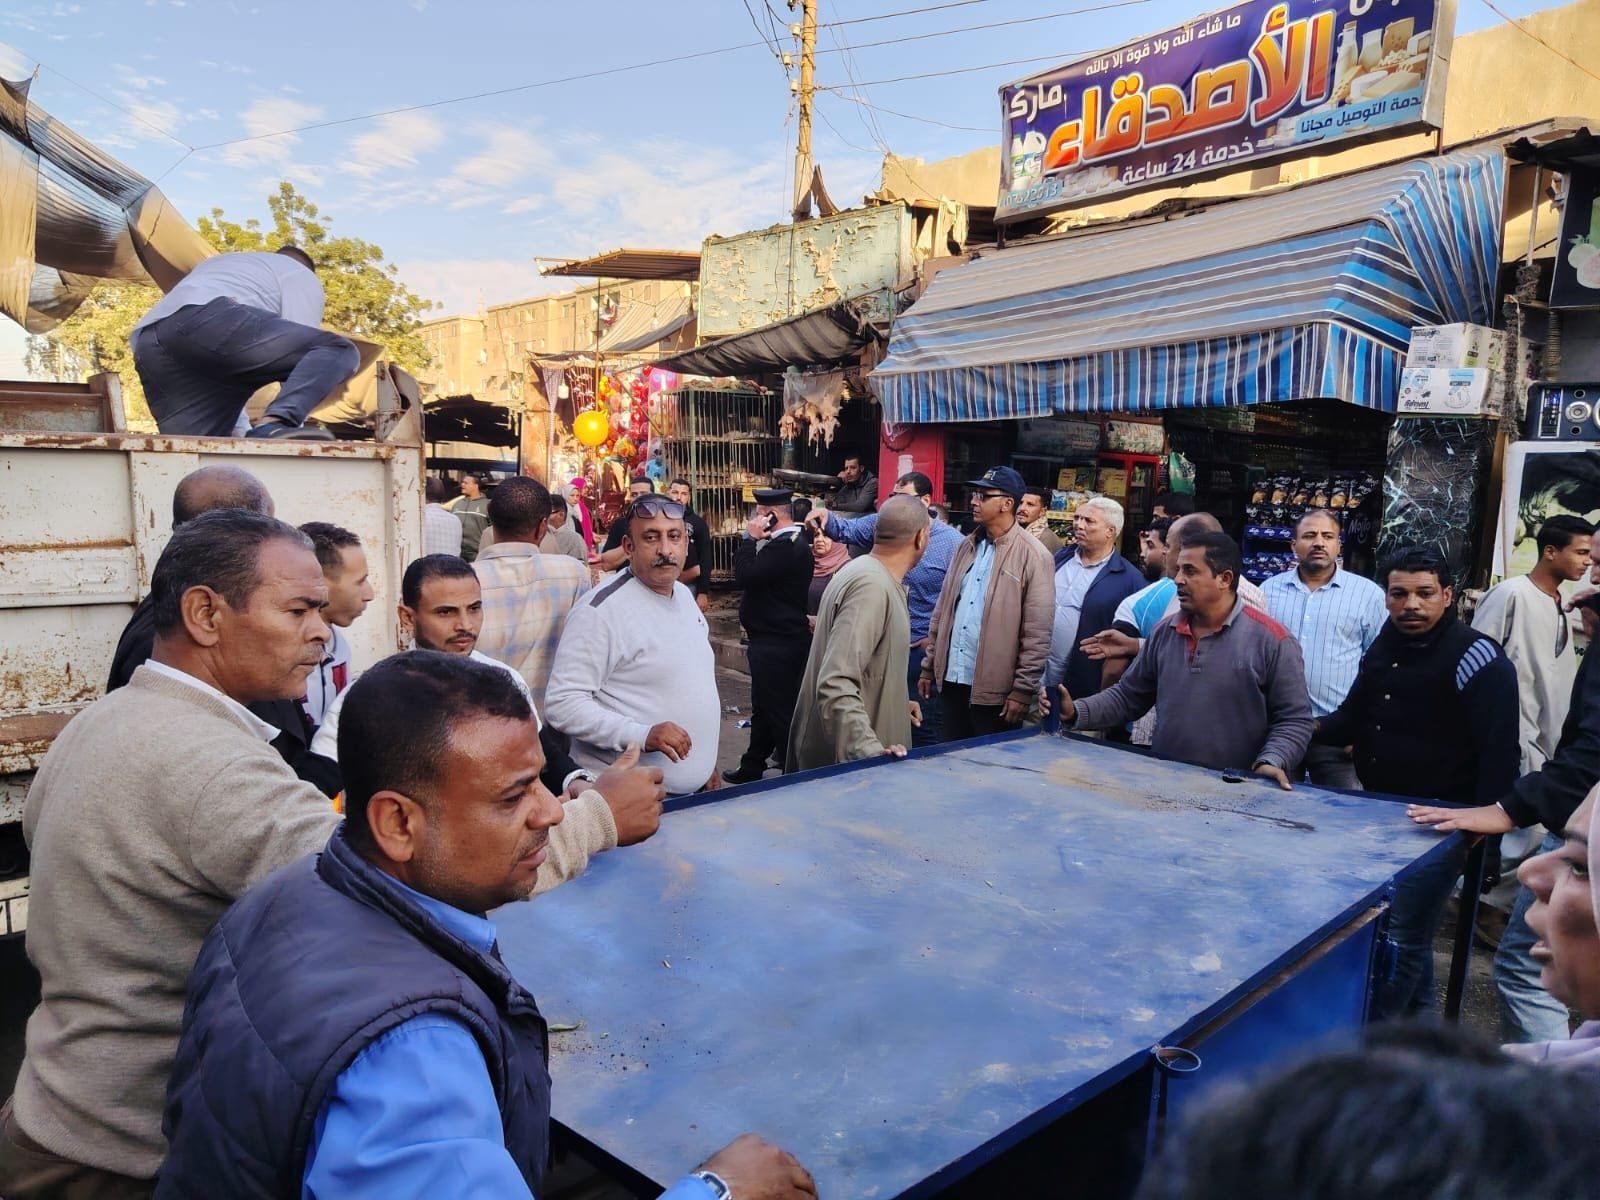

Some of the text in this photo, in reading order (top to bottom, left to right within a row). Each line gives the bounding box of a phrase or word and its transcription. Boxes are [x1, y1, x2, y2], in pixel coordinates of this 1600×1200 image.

[1085, 14, 1241, 76] ما شاء الله ولا قوة إلا بالله
[1007, 83, 1062, 123] مارك
[1041, 3, 1336, 174] الأصدقاء
[1301, 117, 1333, 135] مجانا
[1336, 101, 1386, 127] التوصيل
[1122, 136, 1254, 185] خدمة 24 ساعة
